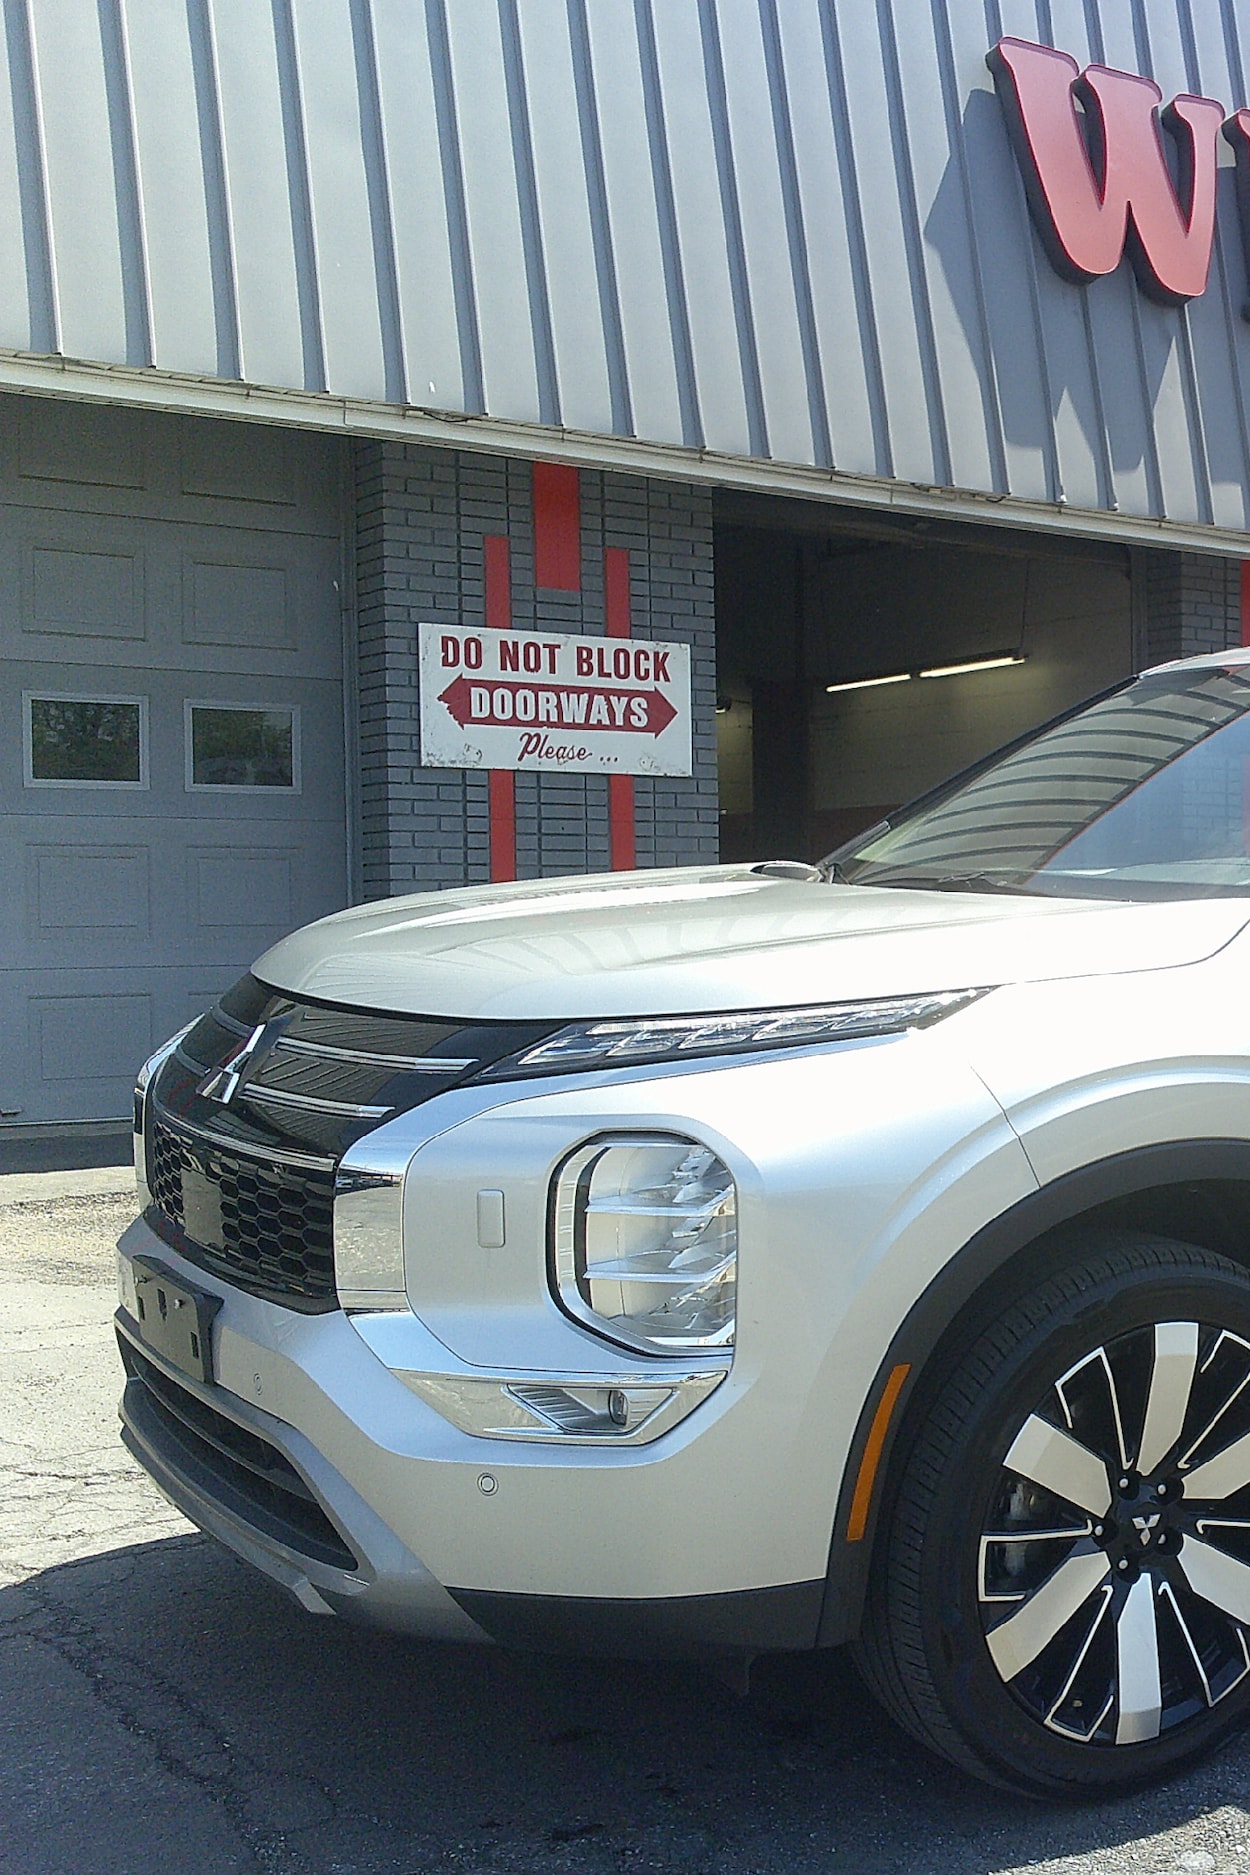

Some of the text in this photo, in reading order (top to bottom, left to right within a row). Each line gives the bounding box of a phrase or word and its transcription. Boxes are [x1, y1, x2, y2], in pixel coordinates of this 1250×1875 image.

[441, 635, 671, 683] DO NOT BLOCK
[470, 687, 648, 728] DOORWAYS
[518, 732, 593, 762] Please
